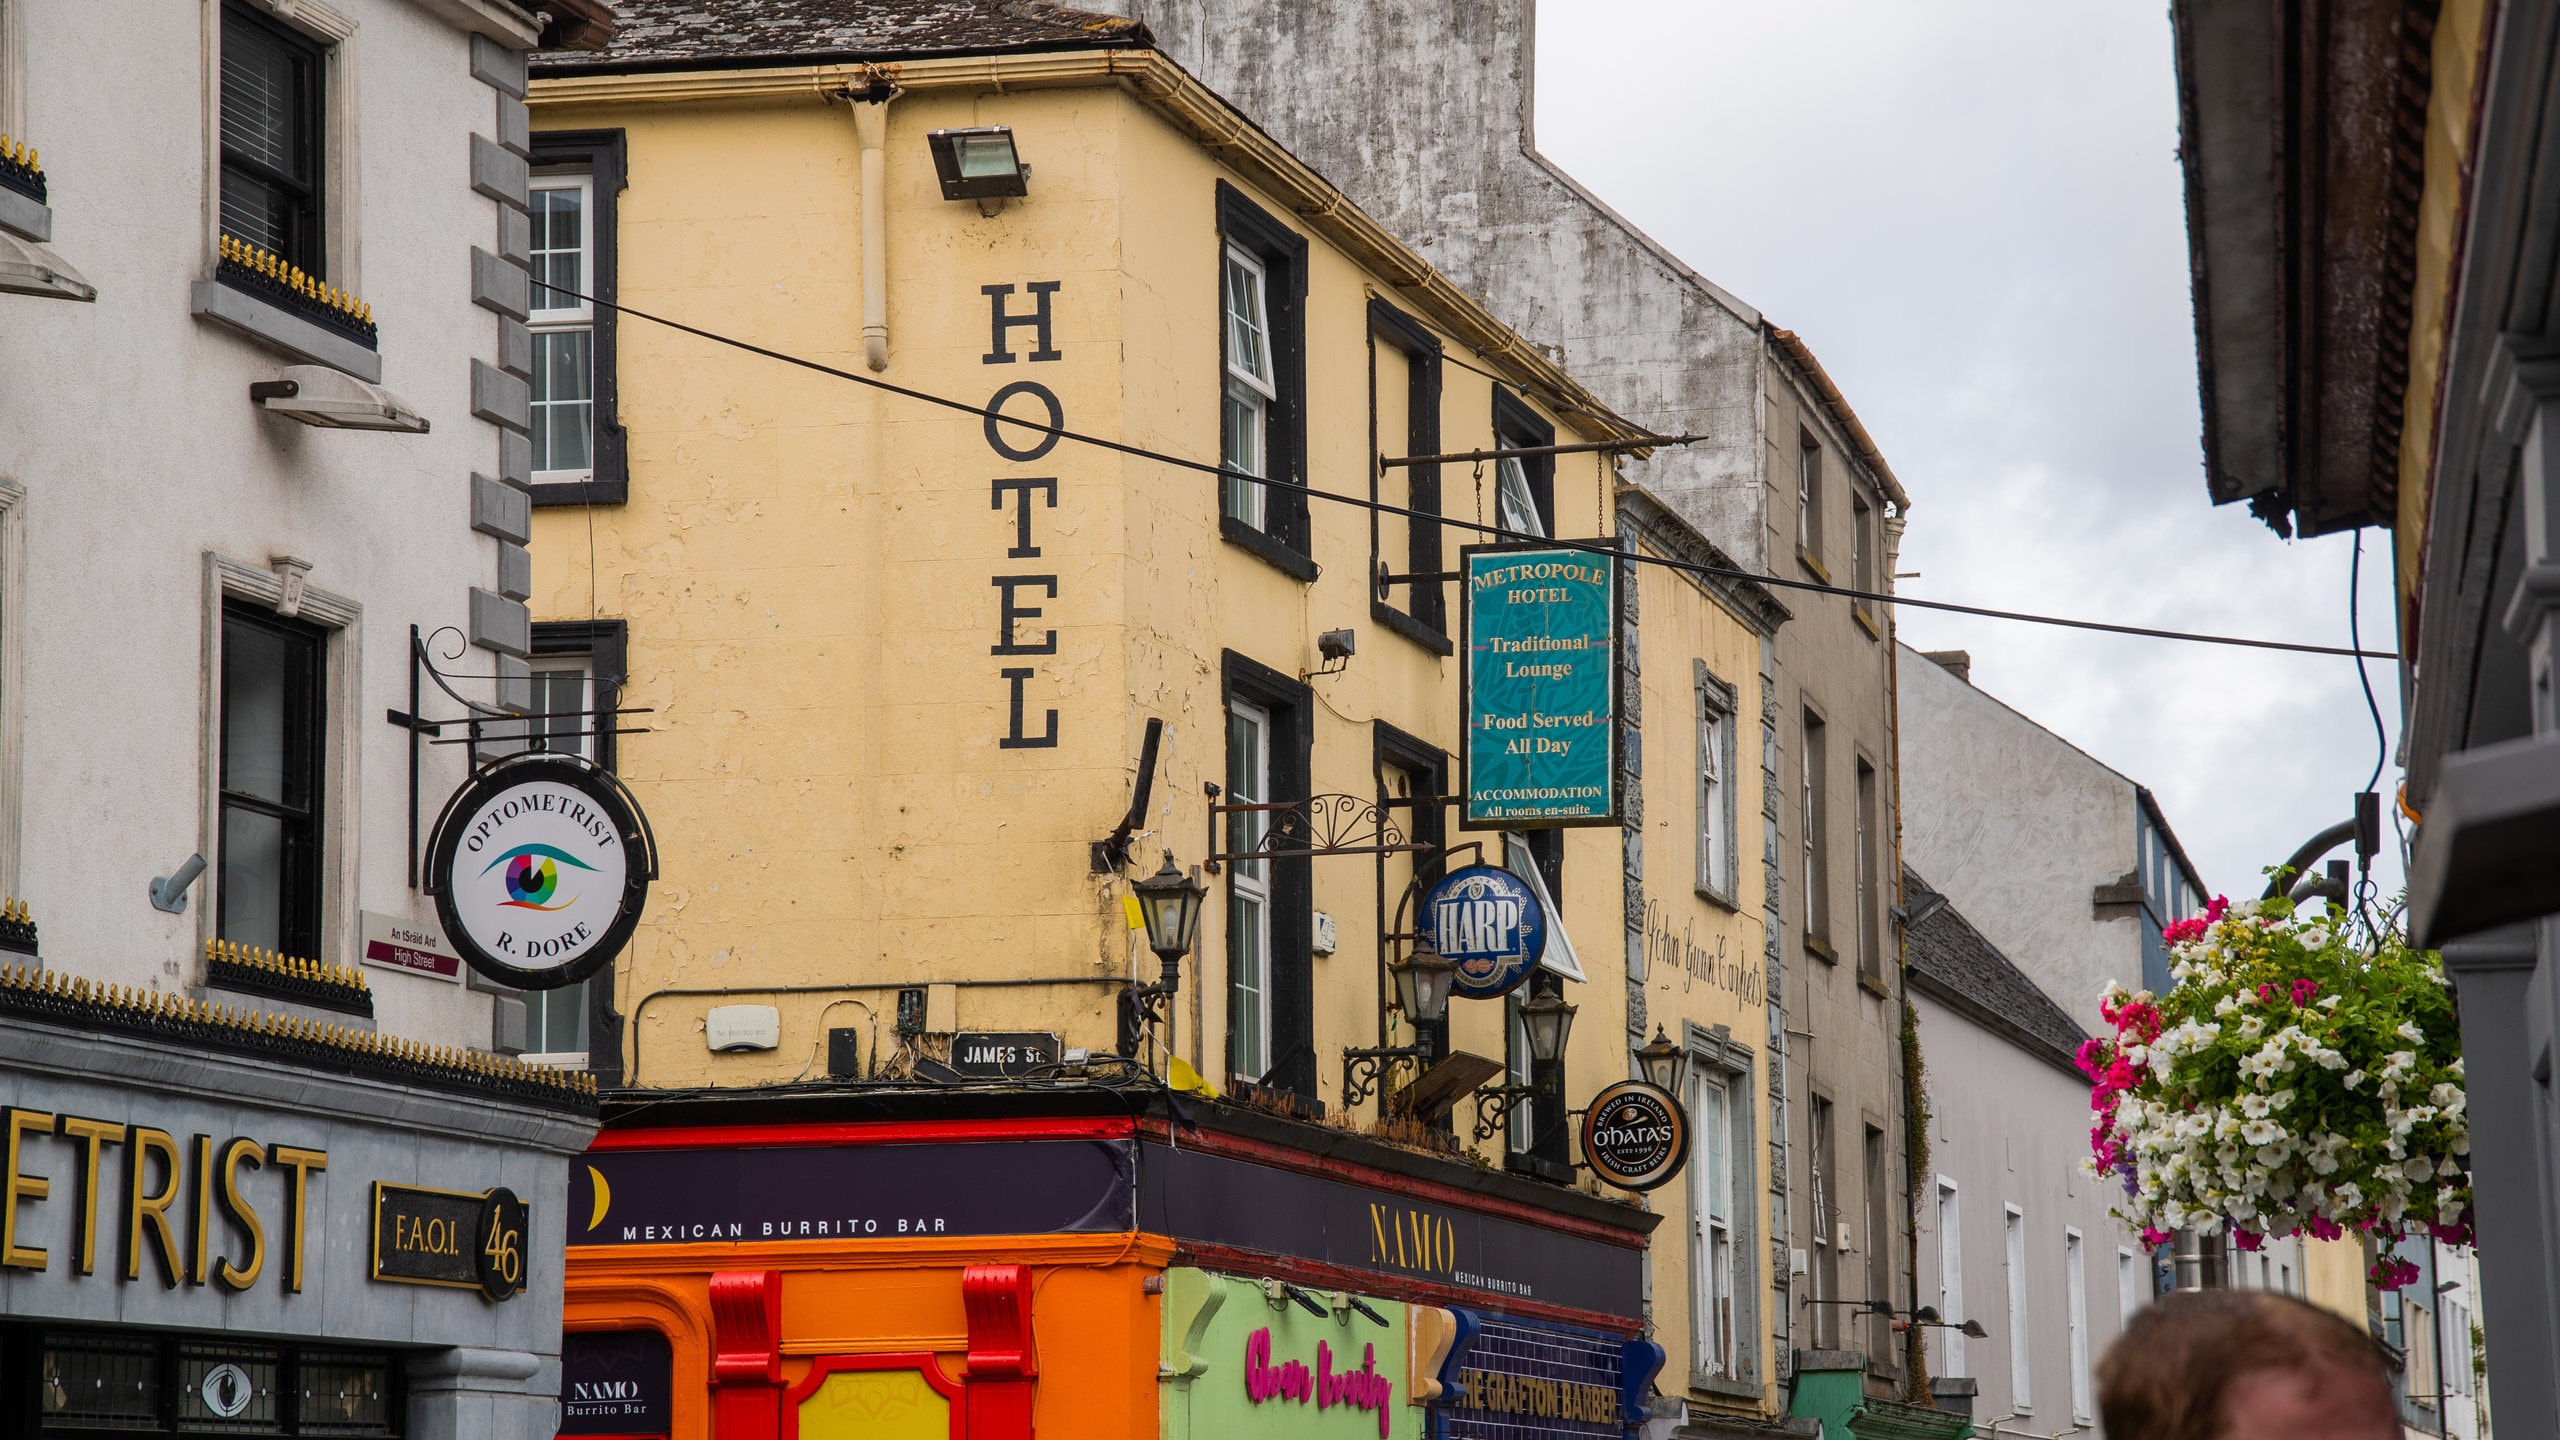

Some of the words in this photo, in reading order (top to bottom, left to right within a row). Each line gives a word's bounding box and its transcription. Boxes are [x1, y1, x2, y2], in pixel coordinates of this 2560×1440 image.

[981, 280, 1064, 749] HOTEL
[1473, 563, 1606, 592] METROPOLE
[1507, 588, 1573, 605] HOTEL
[1489, 634, 1589, 654] Traditional
[1505, 662, 1573, 680] Lounge
[1483, 713, 1528, 730] Food
[1532, 710, 1593, 729] Served
[1504, 738, 1532, 755] All
[1535, 737, 1572, 757] Day
[1473, 786, 1603, 802] ACCOMMODATION
[1485, 806, 1503, 817] All
[1505, 806, 1542, 816] rooms
[1544, 803, 1591, 815] en-suite
[467, 794, 616, 853] OPTOMETRIST
[391, 927, 401, 940] An
[402, 930, 424, 945] tSráid
[424, 935, 437, 948] Ard
[495, 931, 517, 955] R.
[526, 921, 592, 958] DORE
[1439, 900, 1518, 955] HARP
[394, 947, 412, 966] High
[413, 951, 436, 969] Street
[1646, 899, 1680, 982] John
[1684, 917, 1716, 993] Gunn
[1717, 930, 1762, 1012] Carpets
[963, 1046, 1017, 1064] JAMES
[1025, 1046, 1046, 1063] St.
[1597, 1098, 1622, 1127] BREWED
[1624, 1095, 1635, 1103] IN
[1638, 1095, 1668, 1123] IRELAND
[1601, 1151, 1621, 1170] IRISH
[1622, 1164, 1648, 1173] CRAFT
[1650, 1146, 1668, 1167] BEERS
[1635, 1145, 1653, 1154] 1996
[0, 1105, 327, 1295] ETRIST
[395, 1214, 460, 1257] F.A.O.I.
[623, 1223, 742, 1241] MEXICAN
[763, 1219, 878, 1237] BURRITO
[897, 1217, 946, 1233] BAR
[1370, 1203, 1455, 1274] NAMO
[485, 1203, 519, 1284] 46
[1455, 1271, 1484, 1287] MEXICAN
[1488, 1278, 1517, 1293] BURRITO
[1520, 1283, 1532, 1296] BAR
[574, 1381, 638, 1400] NAMO
[1246, 1326, 1315, 1404] Clean
[1318, 1340, 1392, 1439] beauty
[567, 1405, 617, 1416] Burrito
[624, 1403, 647, 1414] Bar
[1486, 1372, 1558, 1417] GRAFTON
[1562, 1382, 1618, 1425] BARBER
